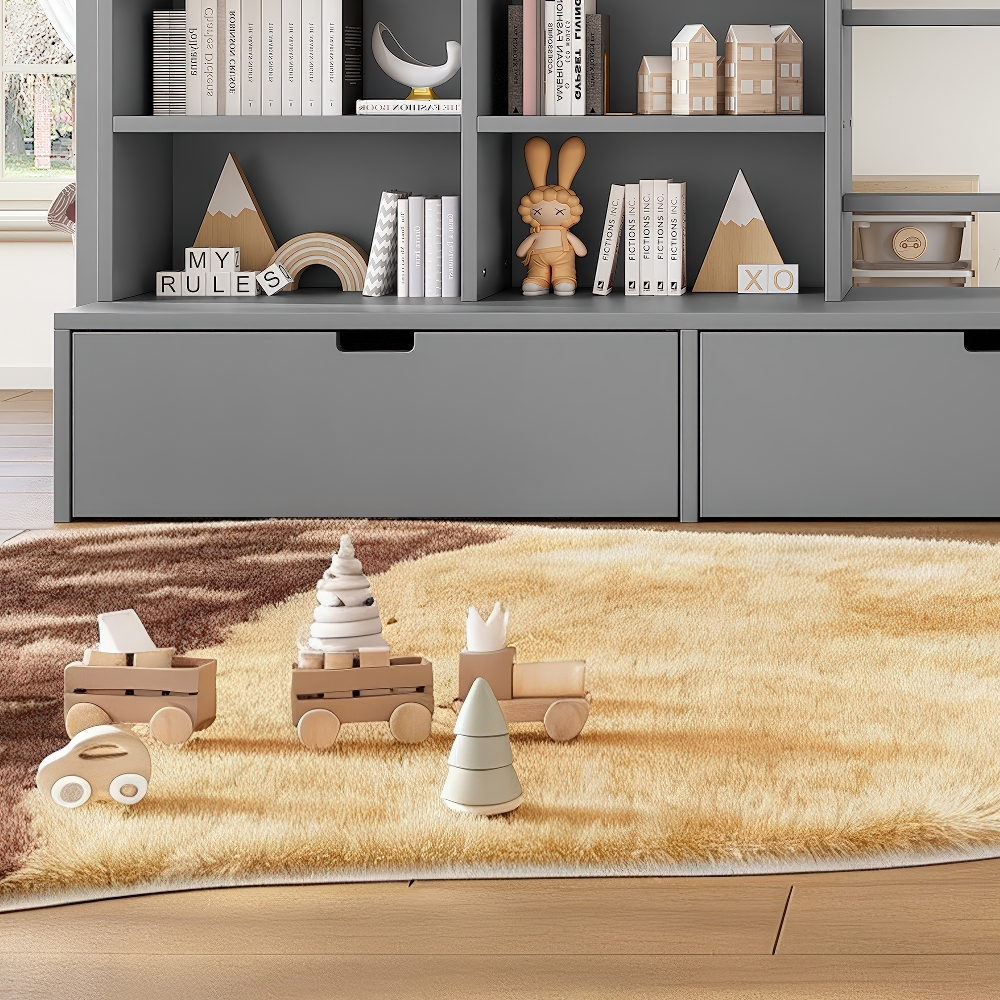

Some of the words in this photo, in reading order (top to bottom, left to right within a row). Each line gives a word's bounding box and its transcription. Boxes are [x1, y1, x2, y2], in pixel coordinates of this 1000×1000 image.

[628, 197, 636, 216] INC.
[602, 218, 616, 261] FICTIONS
[611, 198, 620, 218] INC.
[628, 218, 636, 261] FICTIONS
[190, 252, 230, 268] MY
[161, 271, 280, 293] RULES
